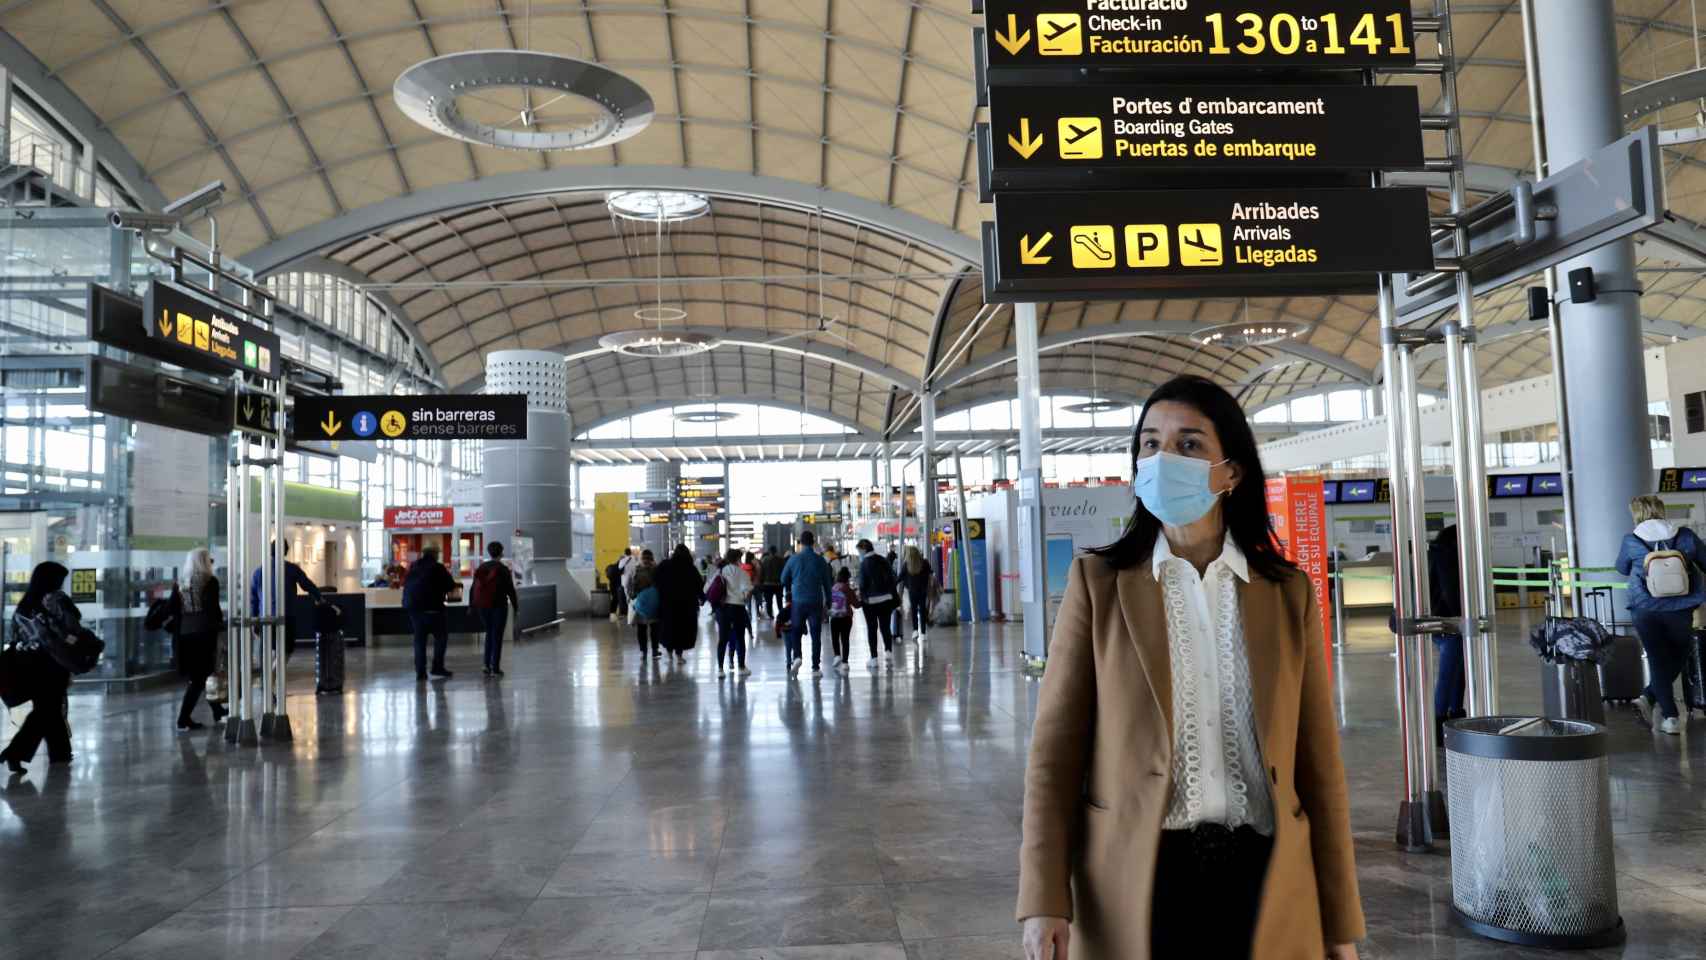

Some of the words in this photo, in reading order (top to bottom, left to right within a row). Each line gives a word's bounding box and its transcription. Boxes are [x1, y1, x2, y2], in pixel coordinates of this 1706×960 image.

[1088, 14, 1162, 32] Check-in
[1205, 12, 1300, 55] 130
[1301, 15, 1318, 31] to
[1320, 12, 1411, 55] 141
[1089, 34, 1203, 54] Facturación
[1305, 39, 1318, 53] a
[1112, 96, 1173, 115] Portes
[1114, 119, 1186, 138] Boarding
[1188, 118, 1235, 135] Gates
[1115, 138, 1189, 157] Puertas
[1193, 138, 1218, 157] de
[1222, 138, 1317, 161] embarque
[1231, 202, 1320, 221] Arribades
[1232, 224, 1292, 241] Arrivals
[1235, 244, 1318, 268] Llegadas
[411, 407, 433, 422] sin
[436, 407, 496, 422] barreras
[412, 422, 455, 436] sense
[457, 421, 517, 435] barreres
[1295, 499, 1309, 533] HERE
[1308, 491, 1320, 542] EQUIPAJE
[1310, 545, 1321, 559] SU
[1311, 561, 1321, 575] DE
